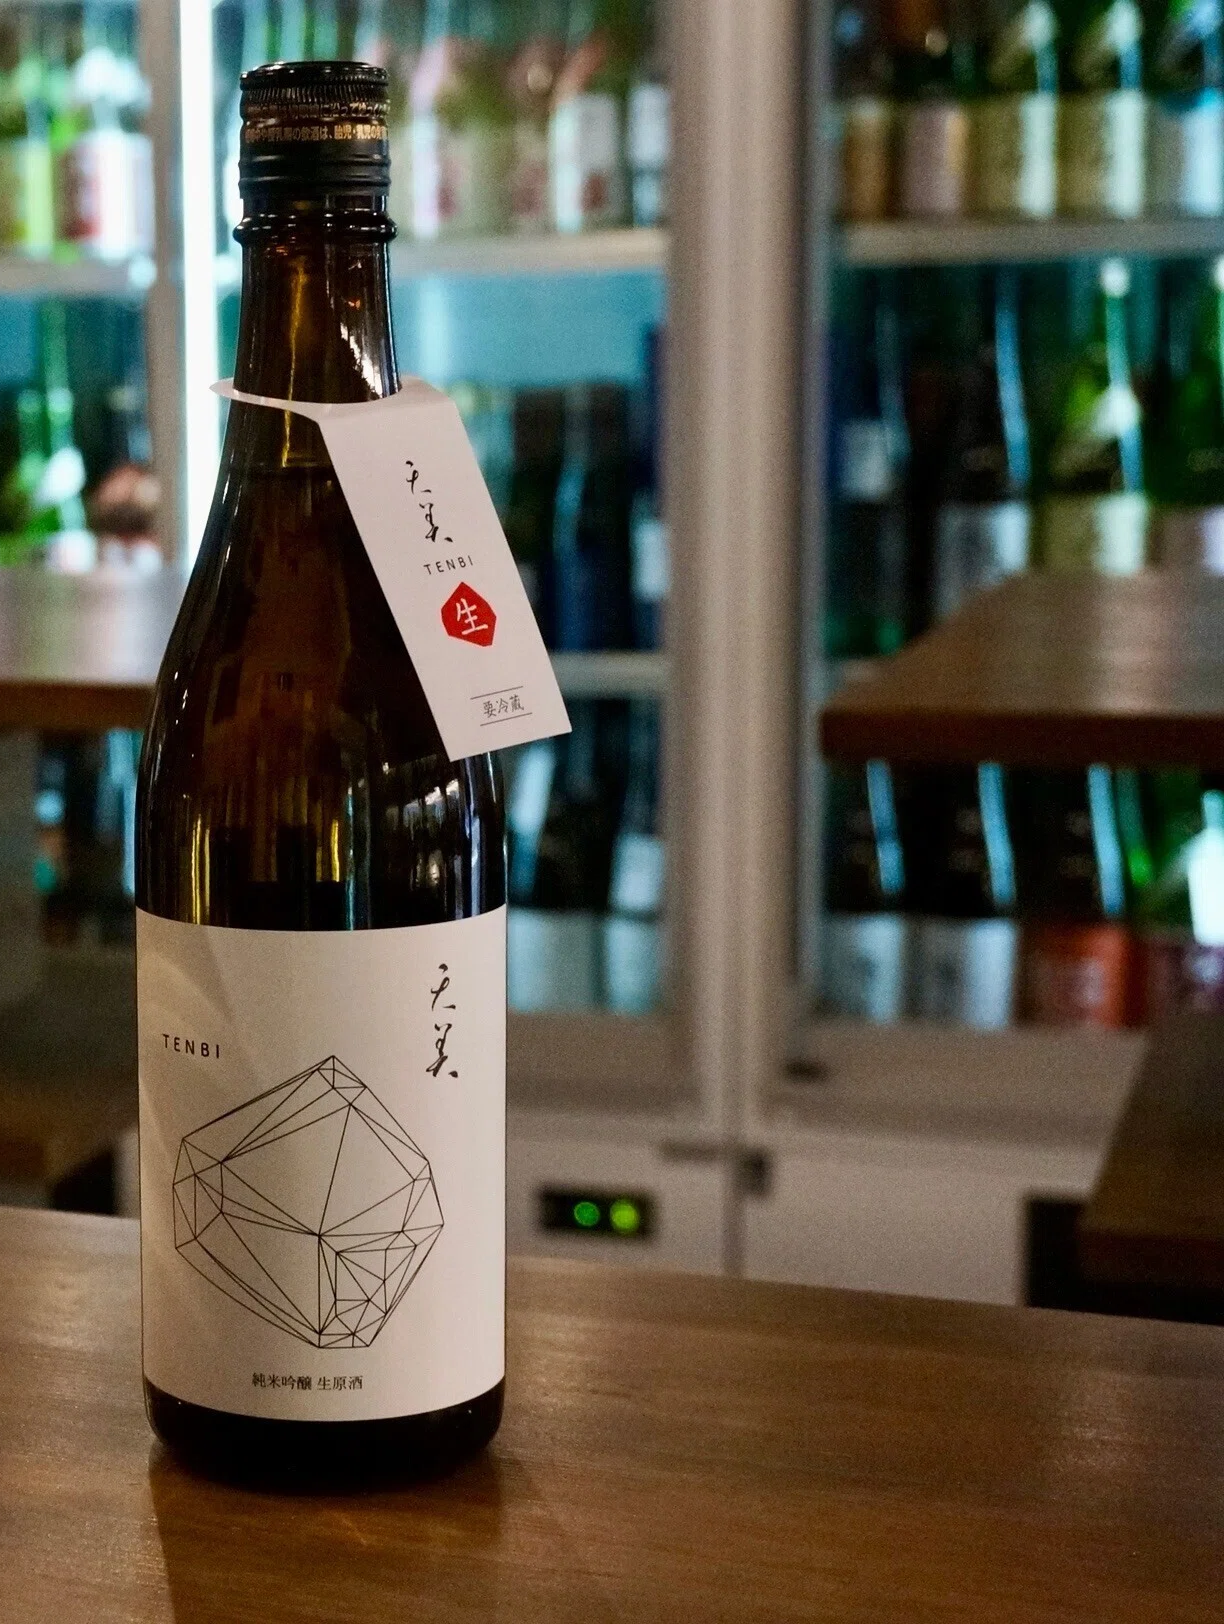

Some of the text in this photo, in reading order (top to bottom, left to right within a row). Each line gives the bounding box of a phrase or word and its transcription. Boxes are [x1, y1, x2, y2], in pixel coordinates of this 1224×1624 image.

[423, 555, 474, 576] TENBI
[455, 597, 489, 635] 生
[482, 694, 524, 718] 要冷蔵
[162, 1033, 221, 1060] TENBI
[317, 1375, 363, 1391] 生原酒
